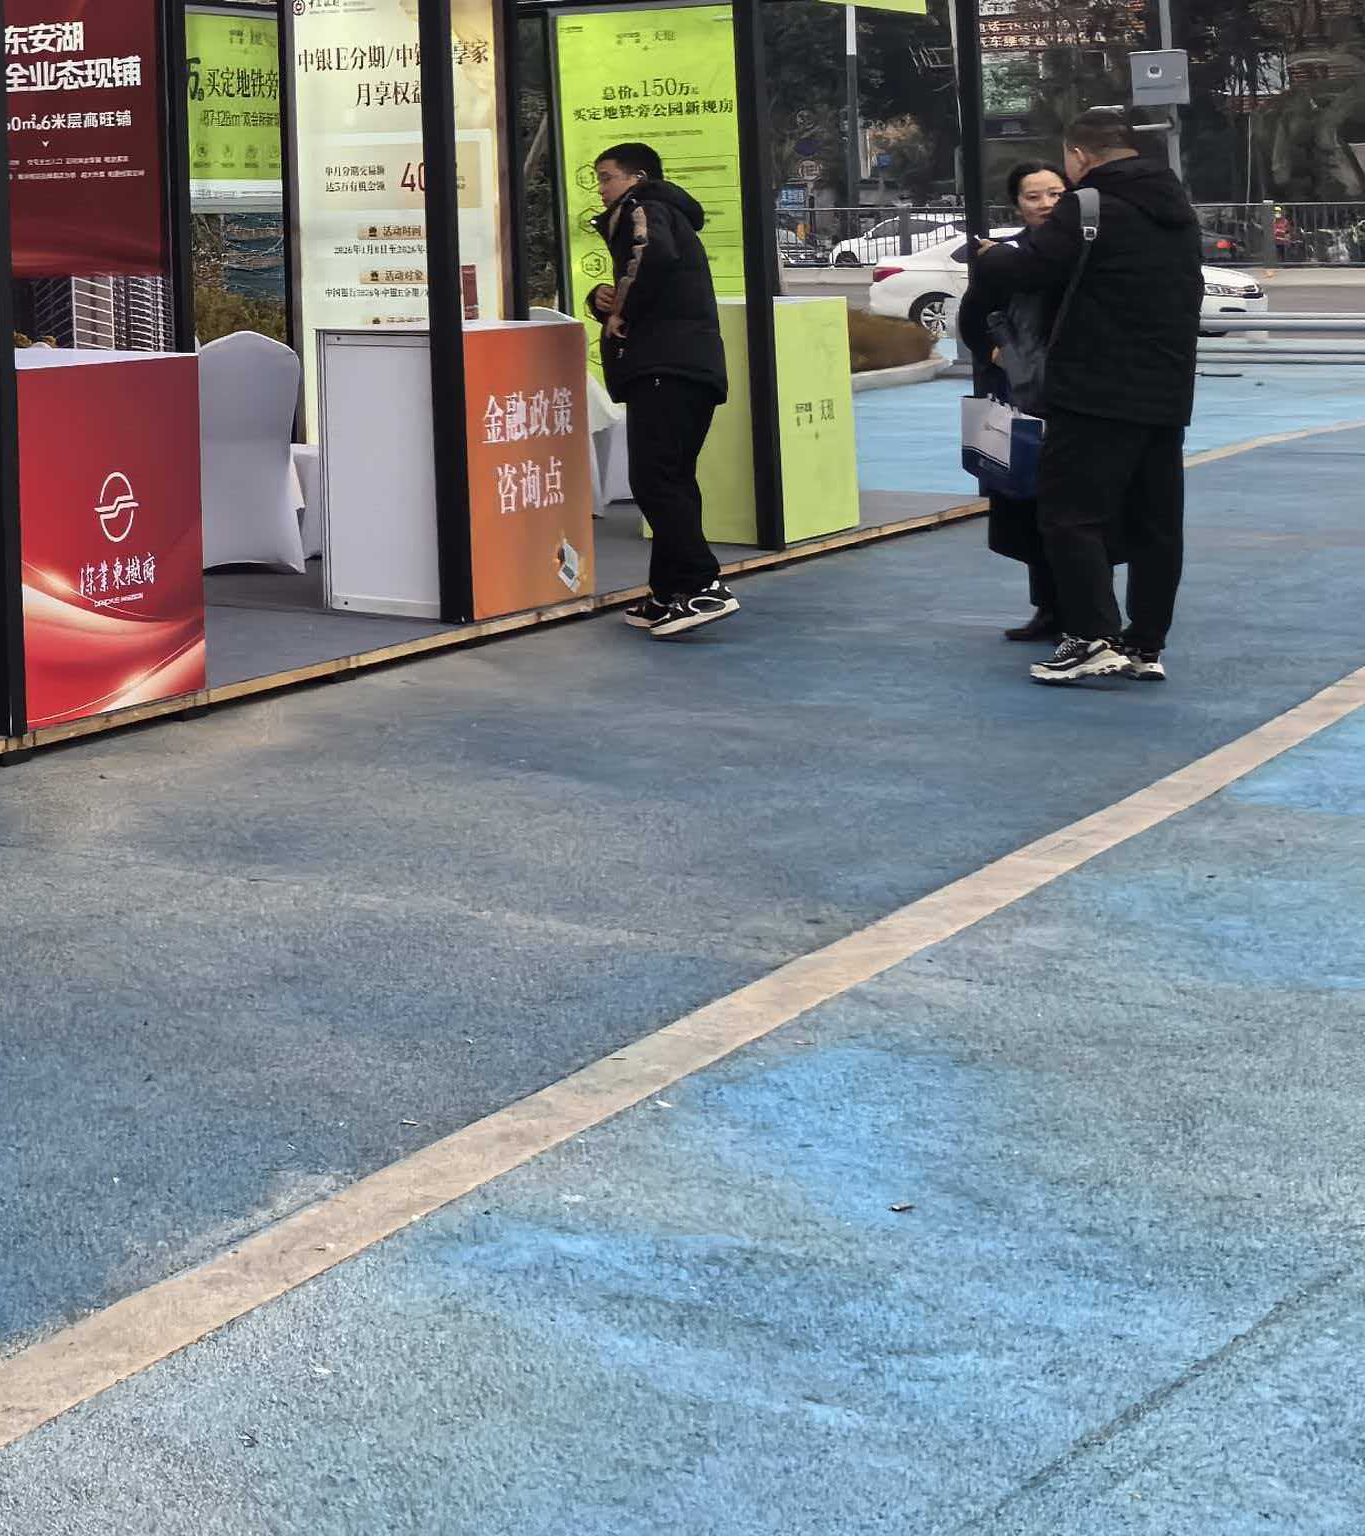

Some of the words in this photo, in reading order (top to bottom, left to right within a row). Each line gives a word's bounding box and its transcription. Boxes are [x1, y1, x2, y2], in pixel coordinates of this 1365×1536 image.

[4, 21, 84, 55] 东安湖
[573, 97, 733, 121] 买定地铁旁公园新规房
[481, 385, 574, 445] 金融政策
[495, 454, 566, 515] 咨询点
